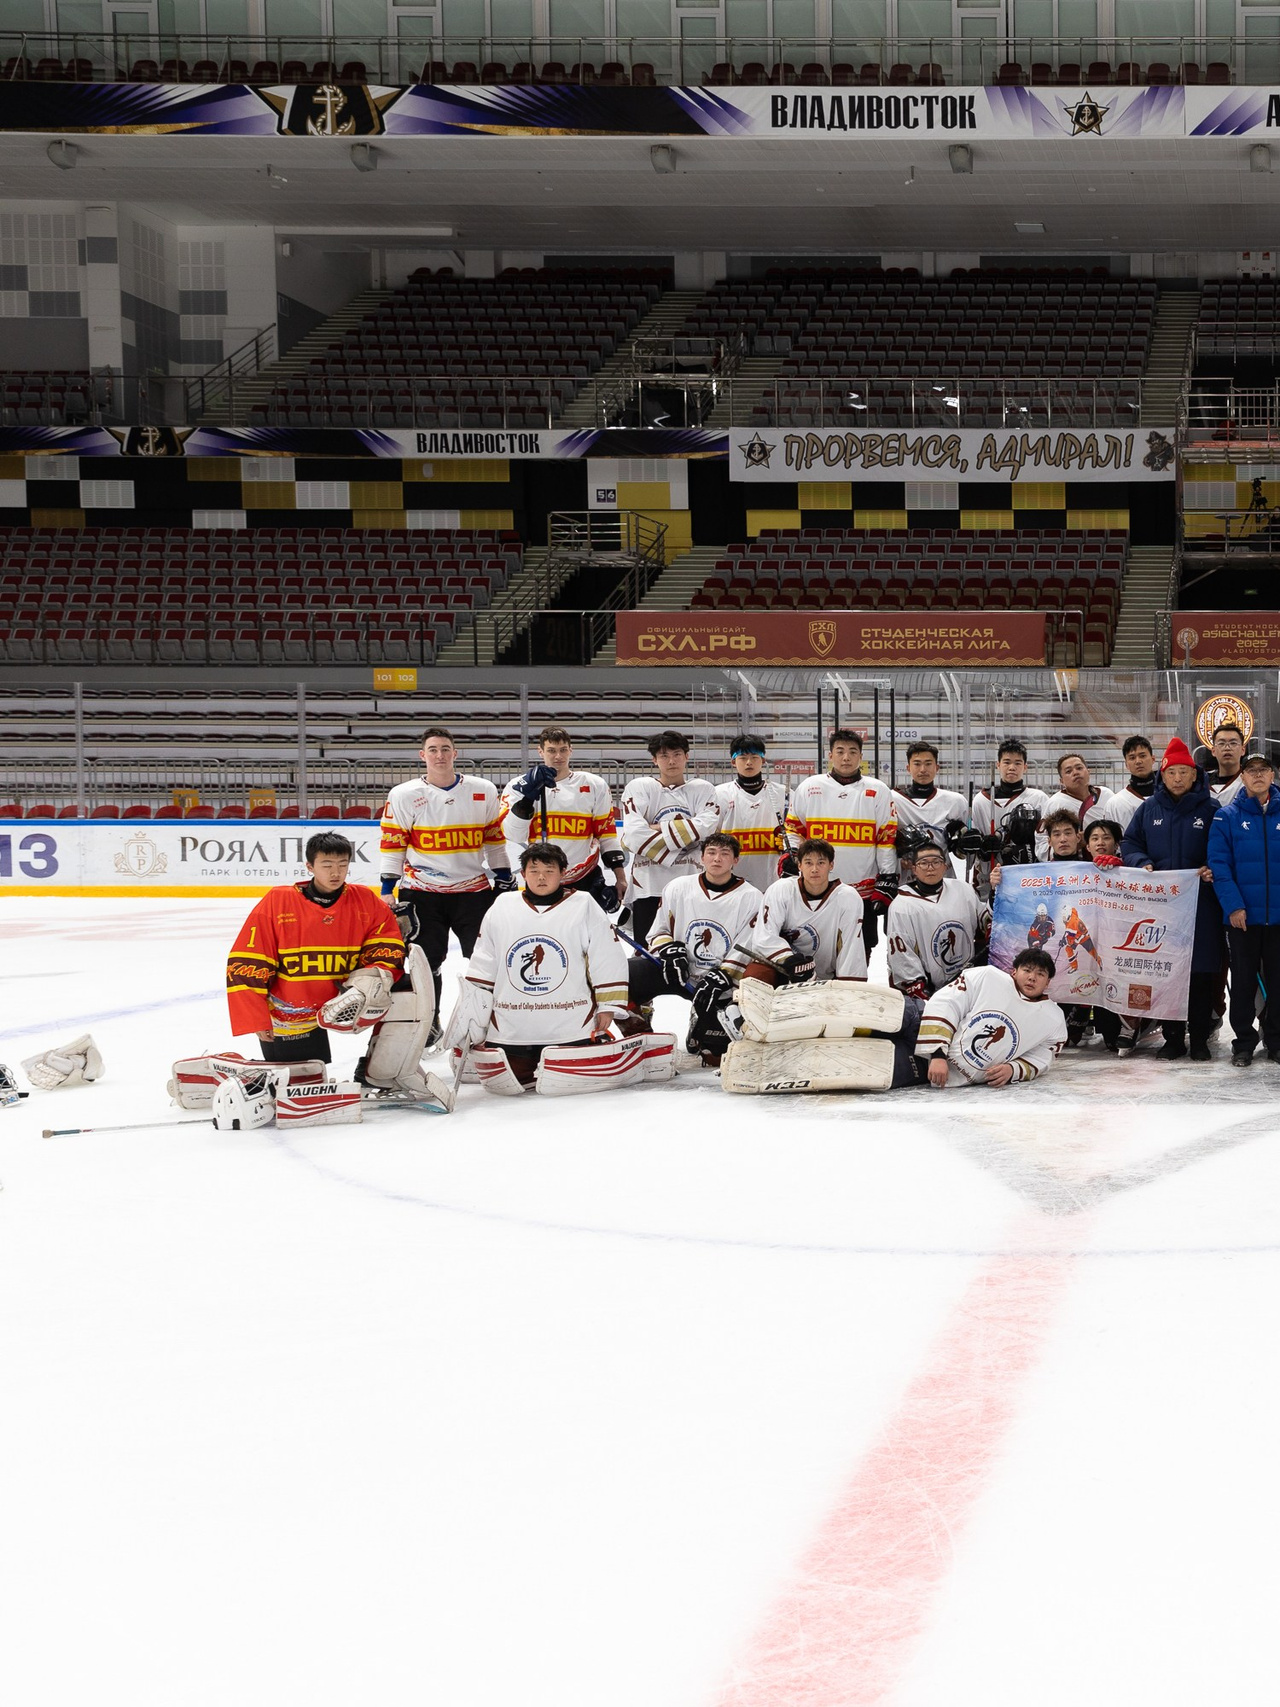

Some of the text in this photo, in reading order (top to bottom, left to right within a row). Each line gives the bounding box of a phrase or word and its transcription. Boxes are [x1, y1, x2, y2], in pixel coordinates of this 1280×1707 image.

[770, 94, 976, 130] ВЛАДИВОСТОК
[416, 432, 540, 454] ВЛАДИВОСТОК
[783, 432, 1135, 480] ПРОРВЕМСЯ, АДМИРАЛ!
[597, 490, 616, 499] 5 6
[647, 626, 721, 634] ОФИЦИАЛЬНЫЙ
[860, 628, 994, 639] СТУДЕНЧЕСКАЯ
[637, 634, 757, 652] СХЛ.РФ
[860, 638, 1012, 650] ХОККЕЙНАЯ ЛИГА
[1236, 639, 1268, 648] 2025
[398, 674, 415, 682] 102
[419, 829, 483, 850] CHINA
[809, 823, 874, 842] CHINA
[280, 837, 371, 863] ПК
[201, 868, 231, 877] ПАРК
[244, 868, 280, 877] ОТЕЛЬ
[246, 926, 257, 948] 1
[1113, 955, 1173, 973] 龙威国际体育
[213, 1063, 237, 1075] VAUGHN
[286, 1084, 339, 1098] VAUGHN
[764, 1080, 811, 1091] CCM
